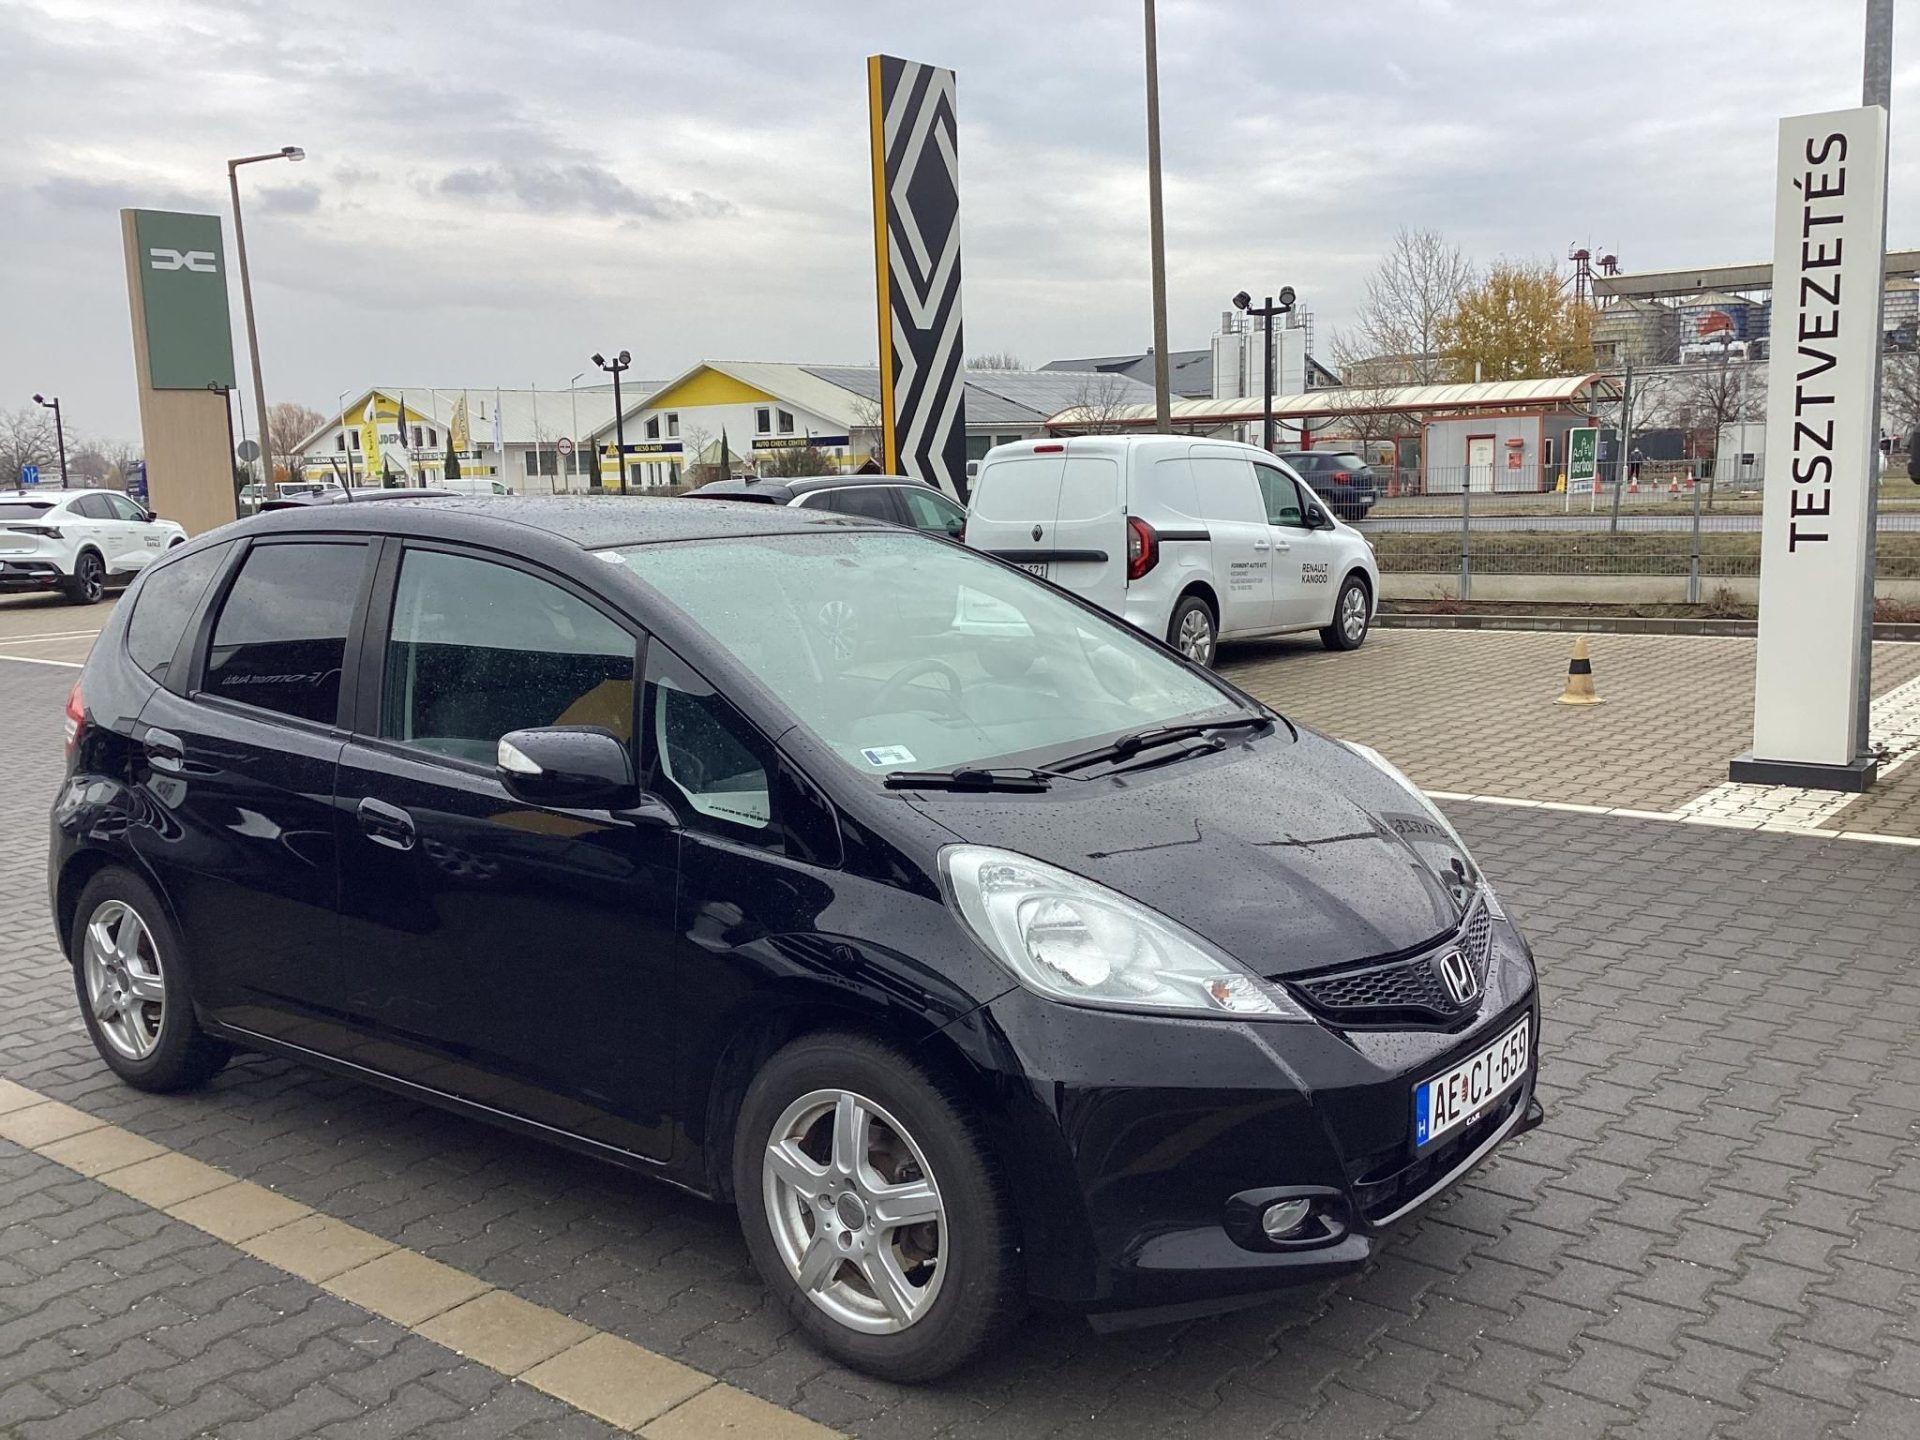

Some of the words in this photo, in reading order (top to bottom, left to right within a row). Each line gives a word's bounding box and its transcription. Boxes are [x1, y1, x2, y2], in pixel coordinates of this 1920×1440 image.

[1789, 132, 1848, 553] TESZTVEZETÉS
[1302, 563, 1328, 573] RENAULT
[1301, 574, 1328, 583] KANGOO
[1434, 1073, 1460, 1130] AE
[1471, 1027, 1526, 1105] CI-659
[1418, 1119, 1426, 1138] H
